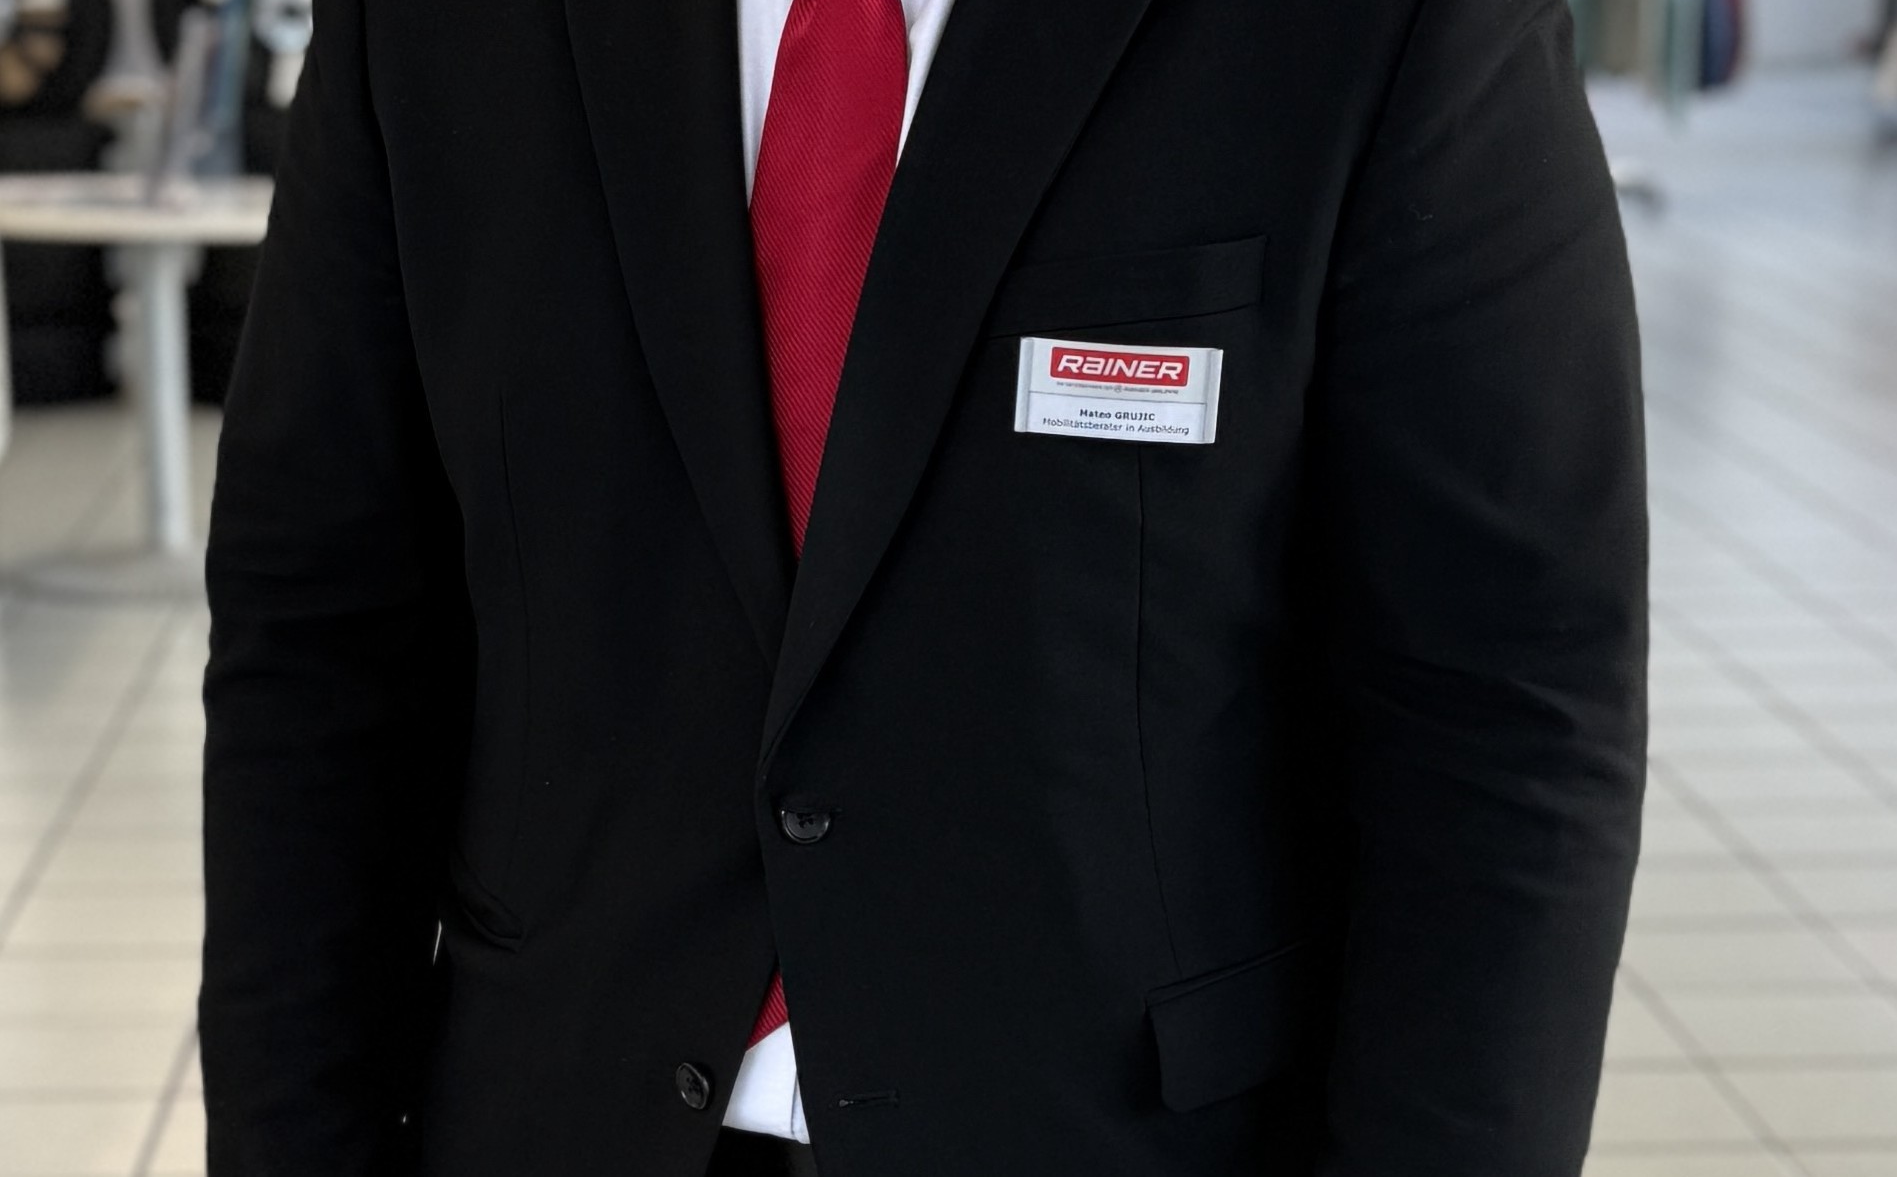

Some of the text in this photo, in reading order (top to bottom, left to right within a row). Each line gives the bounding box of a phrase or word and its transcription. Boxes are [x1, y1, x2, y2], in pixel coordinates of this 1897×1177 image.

[1079, 409, 1156, 421] Mateo GRUJIC
[1126, 424, 1135, 432] in
[1138, 424, 1190, 435] Ausbildung
